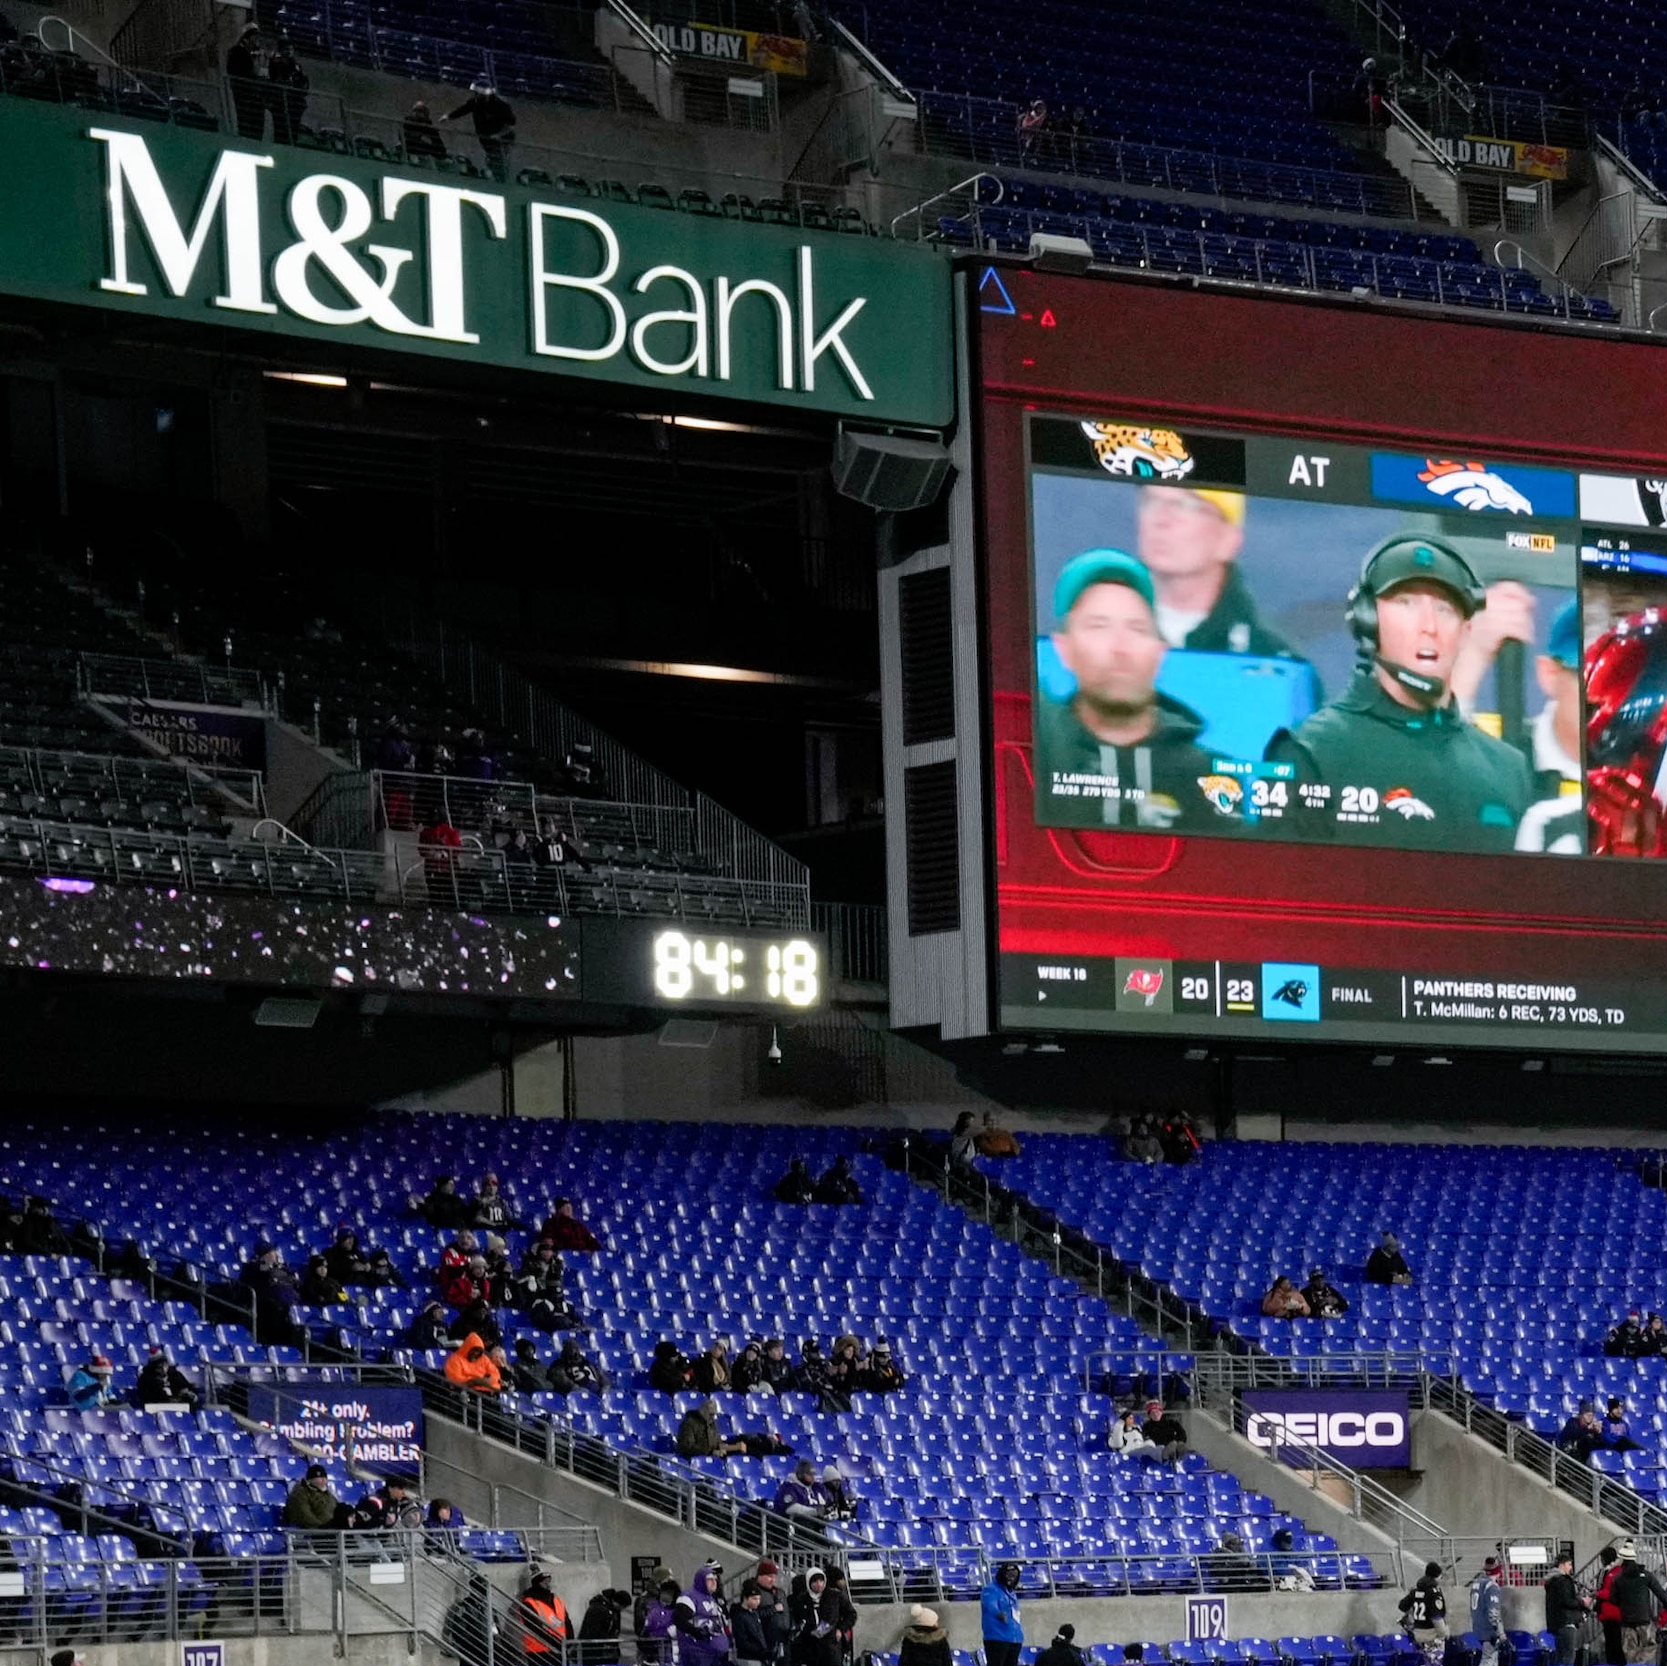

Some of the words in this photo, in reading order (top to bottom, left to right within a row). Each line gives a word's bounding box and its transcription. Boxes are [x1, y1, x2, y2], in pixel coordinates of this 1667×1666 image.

[654, 22, 695, 53] OLD
[701, 30, 742, 60] BAY
[1475, 143, 1511, 168] BAY
[86, 127, 508, 346] M&T
[528, 202, 876, 402] Bank
[1289, 454, 1330, 488] AT
[1531, 534, 1554, 551] NFL
[1062, 772, 1119, 787] LAWRENCE
[1251, 781, 1289, 807] 34
[1299, 785, 1331, 798] 4:32
[1341, 787, 1379, 814] 20
[548, 843, 564, 862] 10
[654, 930, 817, 1006] 84:18
[1038, 967, 1071, 980] WEEK
[1181, 978, 1209, 1000] 20
[1227, 980, 1254, 1001] 23
[1331, 987, 1373, 1003] FINAL
[1413, 980, 1494, 998] PANTHERS
[1496, 984, 1577, 1001] RECEIVING
[1413, 1001, 1427, 1017] T.
[1431, 1002, 1495, 1019] McMillan:
[1499, 1005, 1507, 1019] 6
[1511, 1006, 1544, 1024] REC,
[1548, 1006, 1566, 1022] 73
[1569, 1007, 1602, 1025] YDS,
[1605, 1009, 1625, 1024] TD
[332, 1402, 371, 1420] only.
[1248, 1412, 1405, 1447] GEICO
[1190, 1603, 1223, 1639] 109
